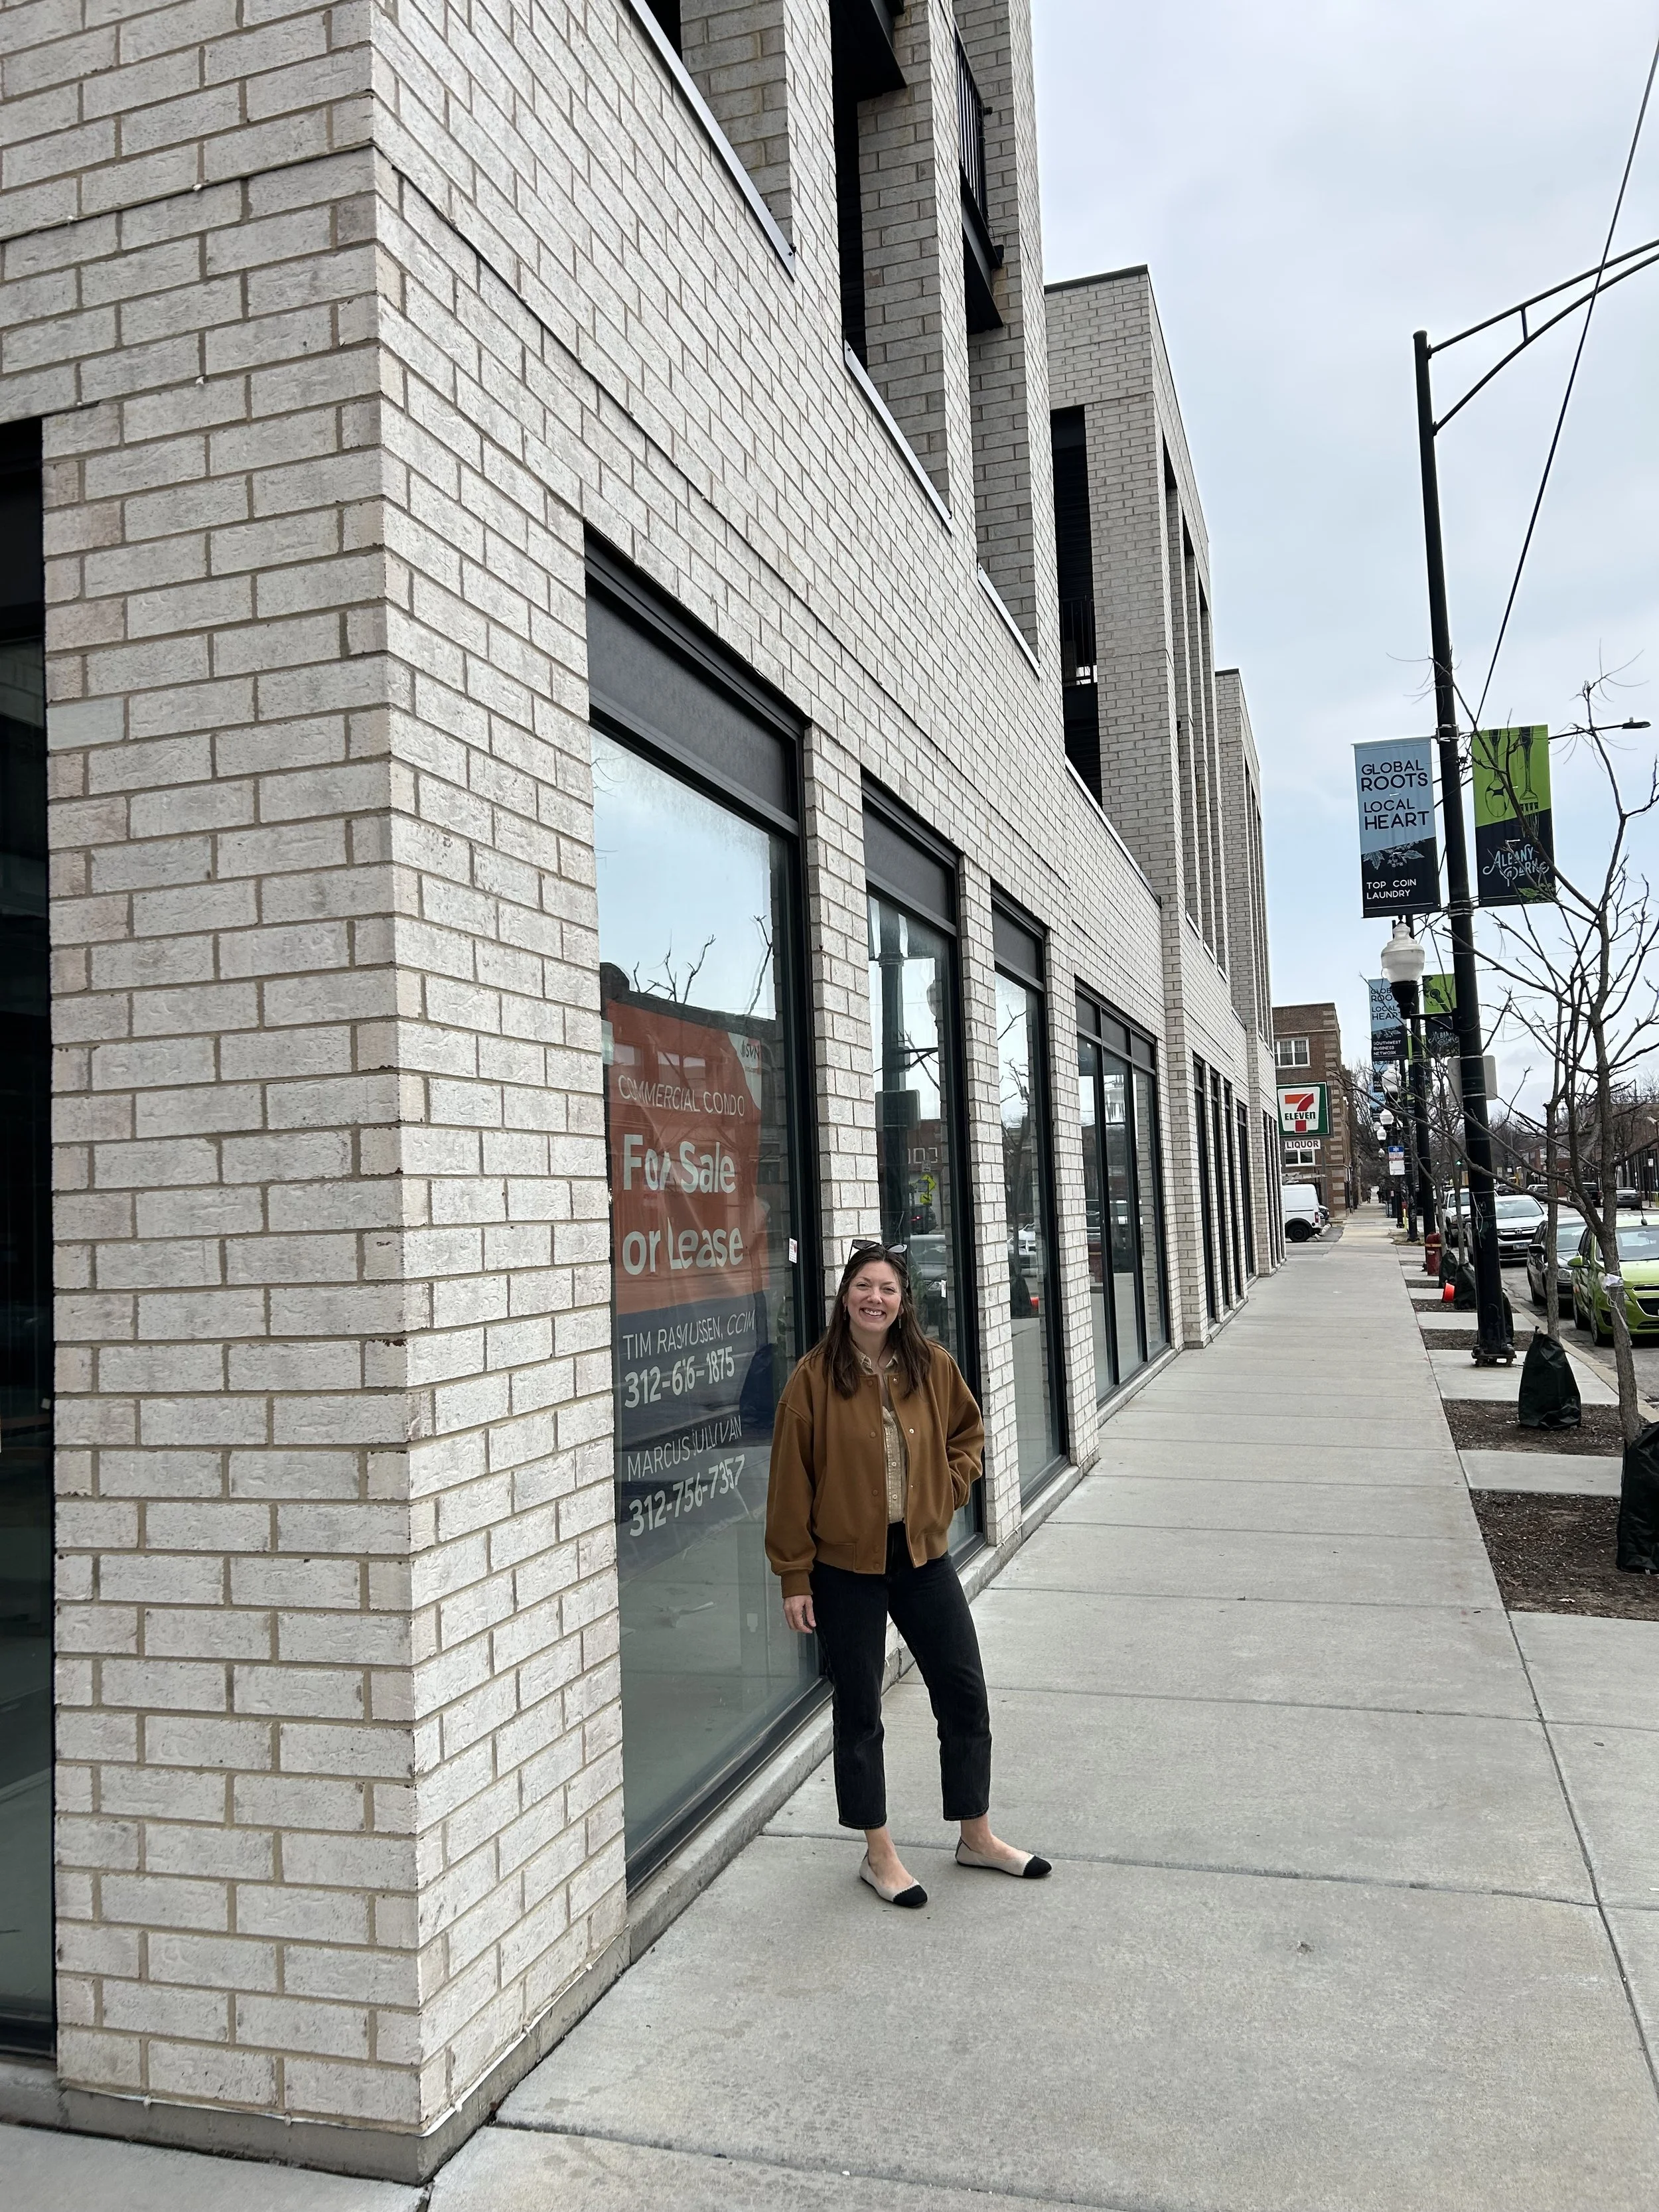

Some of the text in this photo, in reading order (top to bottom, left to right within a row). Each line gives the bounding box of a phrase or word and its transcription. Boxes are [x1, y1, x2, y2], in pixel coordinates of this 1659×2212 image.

[1361, 759, 1425, 775] GLOBAL
[1360, 772, 1429, 792] ROOTS
[1364, 798, 1415, 813] LOCAL
[1364, 810, 1430, 830] HEART
[1366, 878, 1417, 889] TOP COIN
[1366, 889, 1411, 900] LAUNDRY
[746, 1043, 760, 1060] SVN
[618, 1074, 745, 1117] COMMERCIAL CONDO
[1285, 1093, 1314, 1132] 7
[1287, 1140, 1319, 1149] LIQUOR
[623, 1134, 736, 1193] For Sale
[622, 1229, 661, 1276] or
[667, 1217, 744, 1270] Lease
[622, 1331, 652, 1361] TIM
[727, 1309, 755, 1336] CCIM
[627, 1436, 691, 1482] MARCUS
[629, 1453, 745, 1537] 312-756-7357
